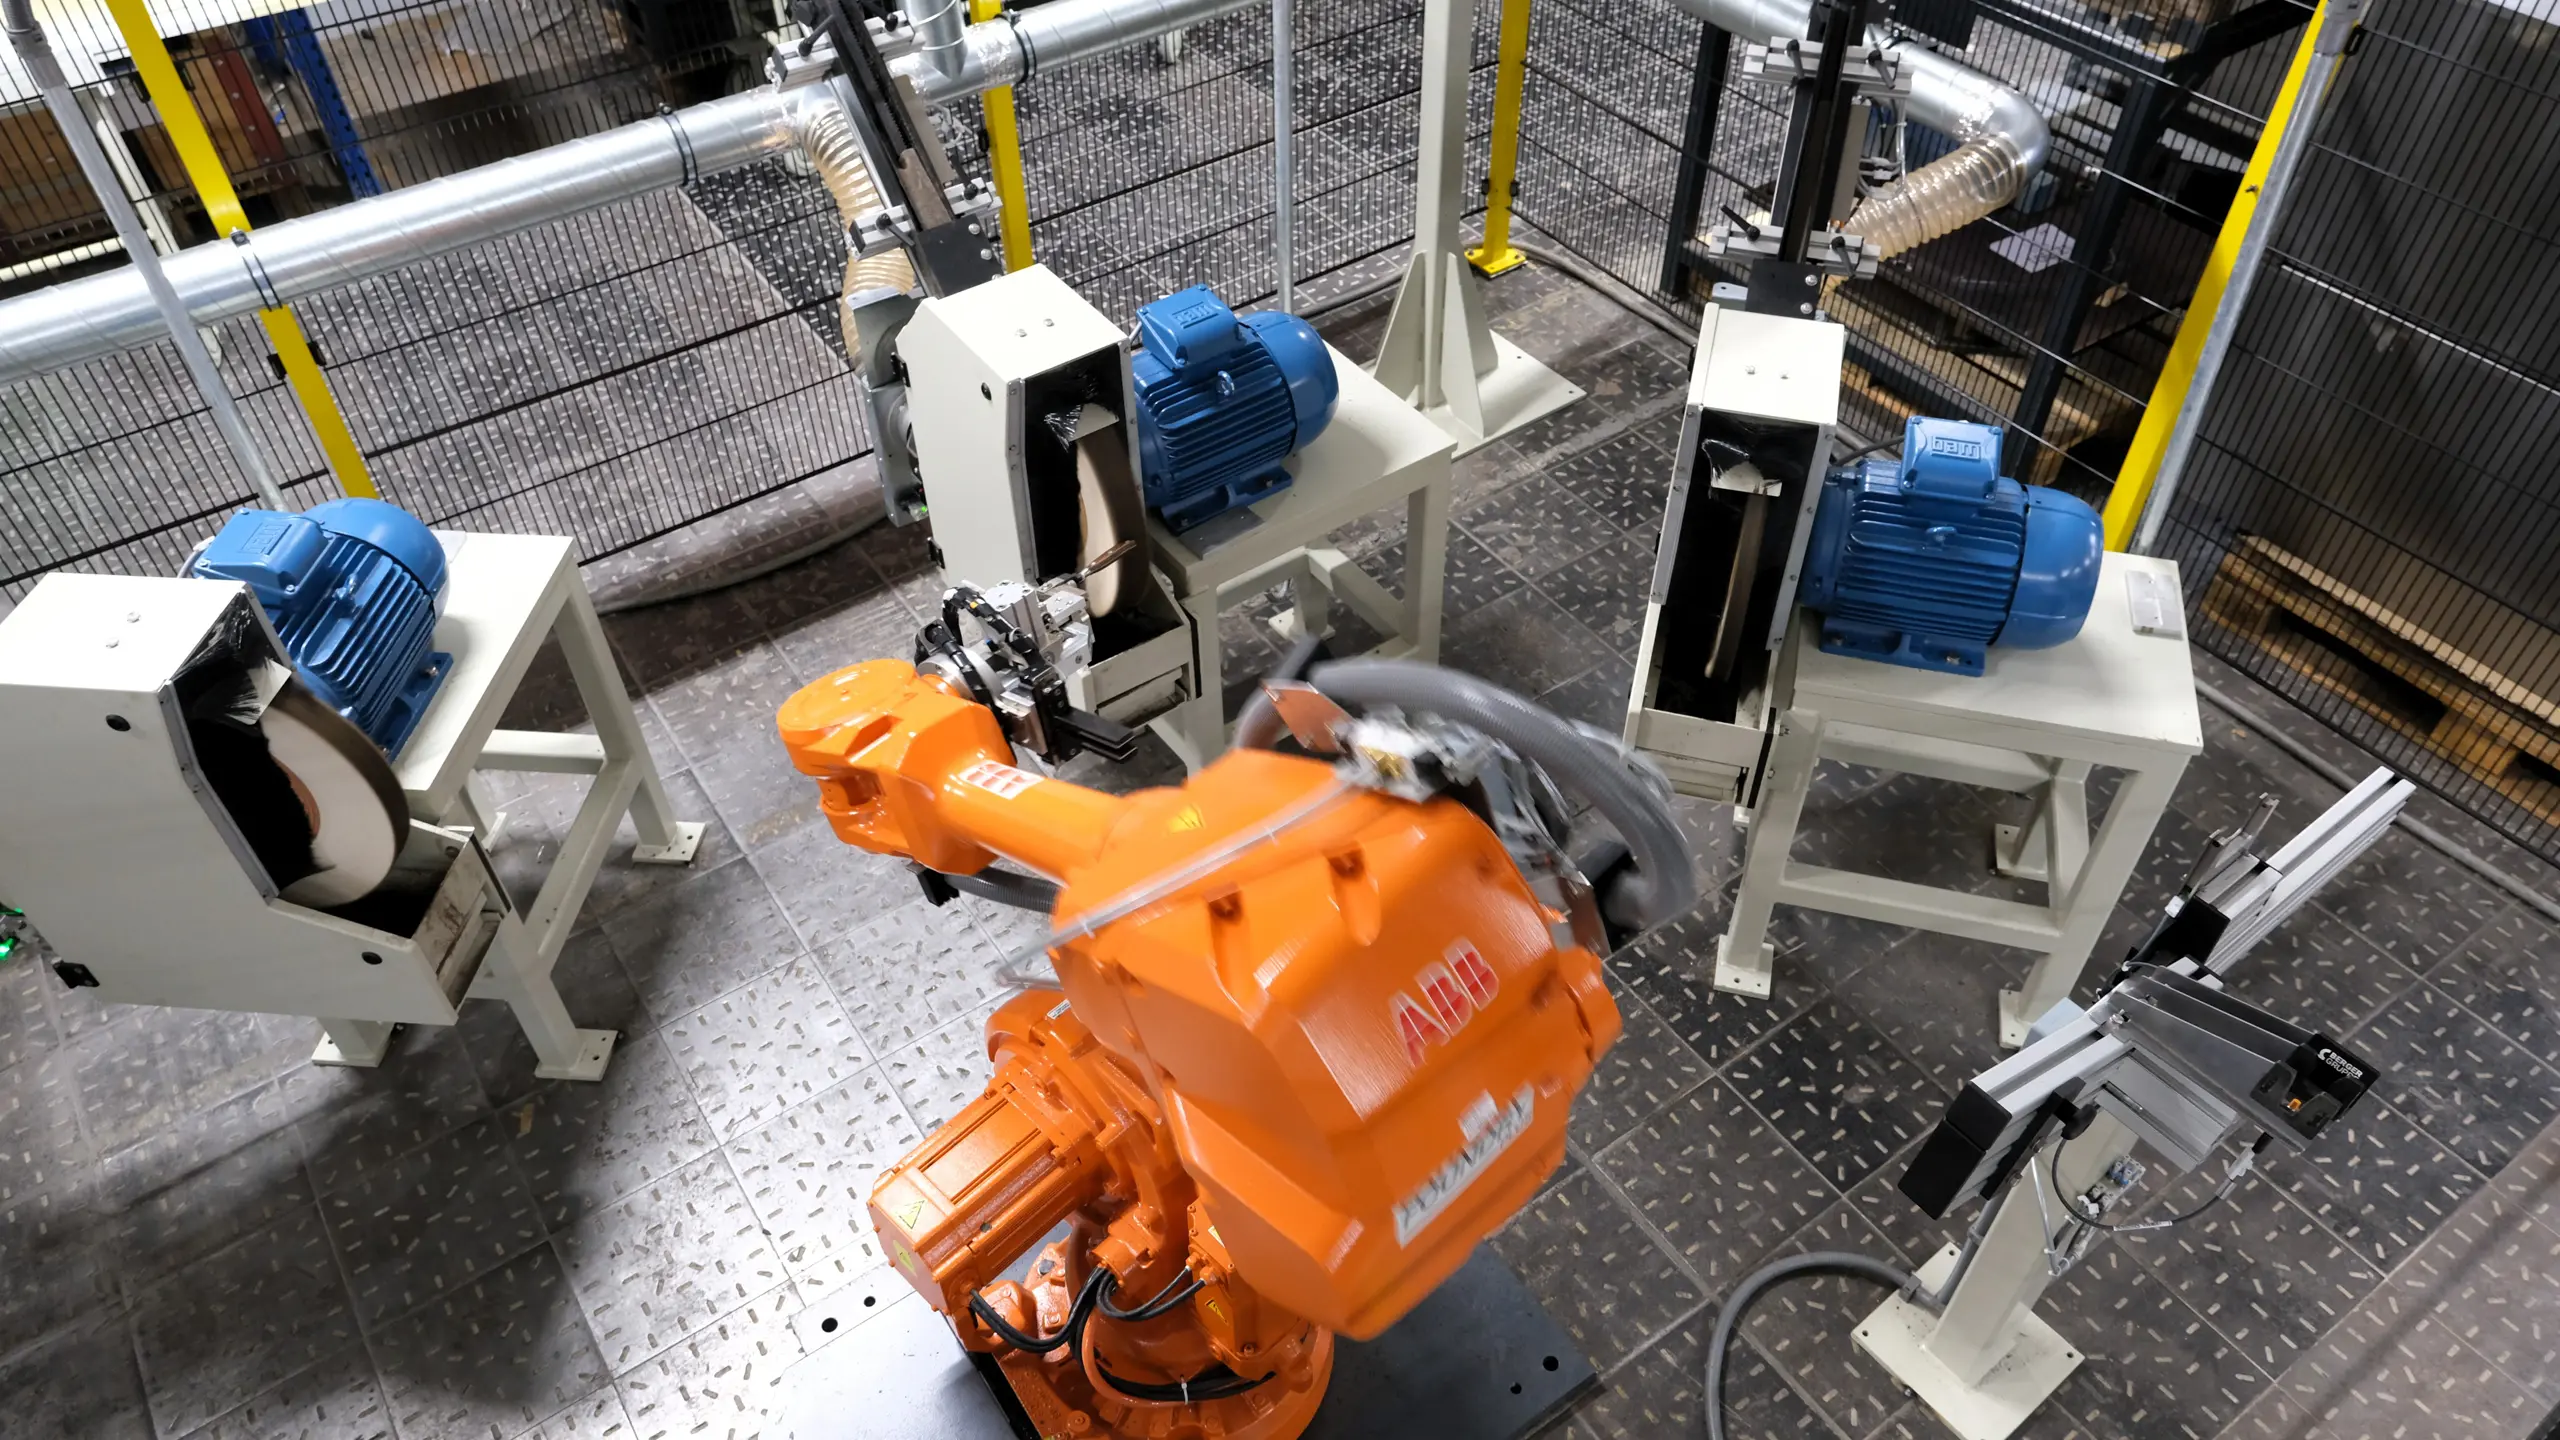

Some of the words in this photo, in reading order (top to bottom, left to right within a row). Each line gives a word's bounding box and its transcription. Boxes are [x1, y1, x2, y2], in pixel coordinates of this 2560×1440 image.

[1930, 437, 1981, 461] WEG
[1389, 937, 1499, 1068] ABB
[2329, 1051, 2363, 1078] BERGER
